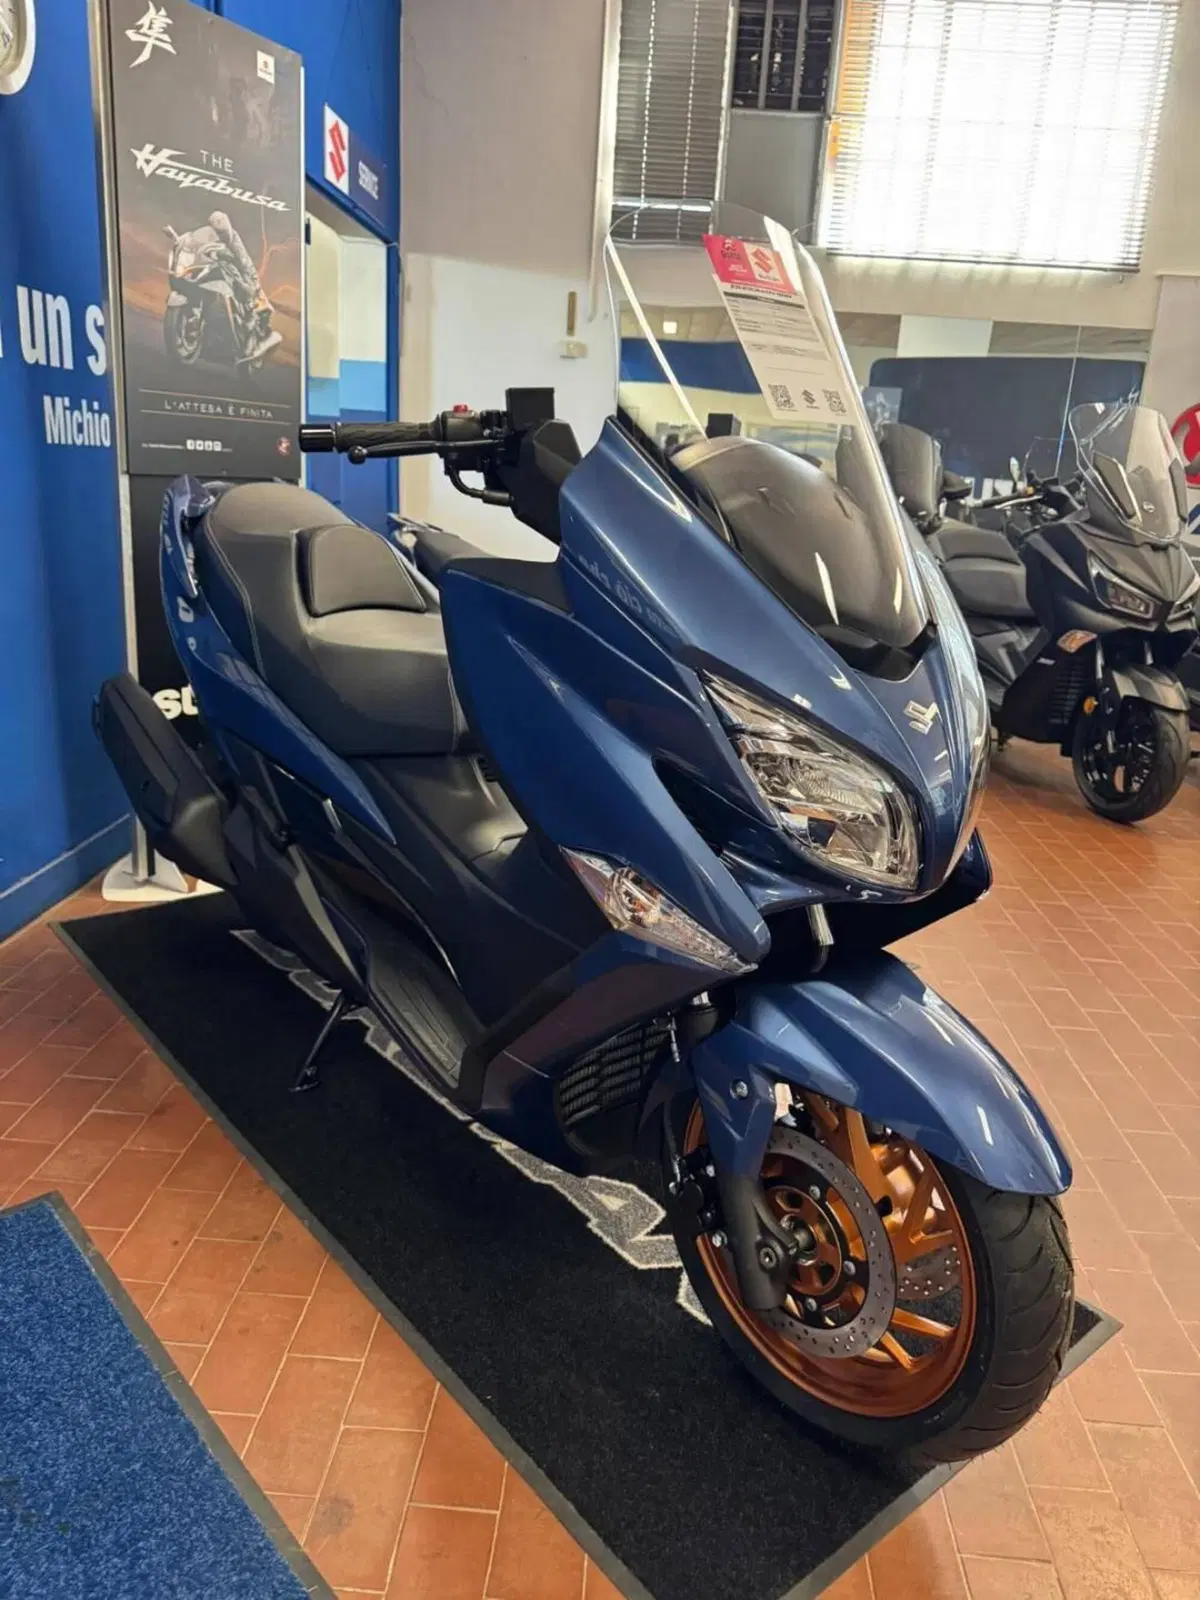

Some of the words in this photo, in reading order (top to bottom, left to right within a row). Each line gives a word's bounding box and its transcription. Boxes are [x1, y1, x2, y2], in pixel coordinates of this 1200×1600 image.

[131, 143, 292, 212] Hayabusa
[200, 149, 234, 173] THE
[16, 285, 74, 370] un
[164, 400, 223, 415] L'ATTESA
[240, 407, 273, 419] FINITA
